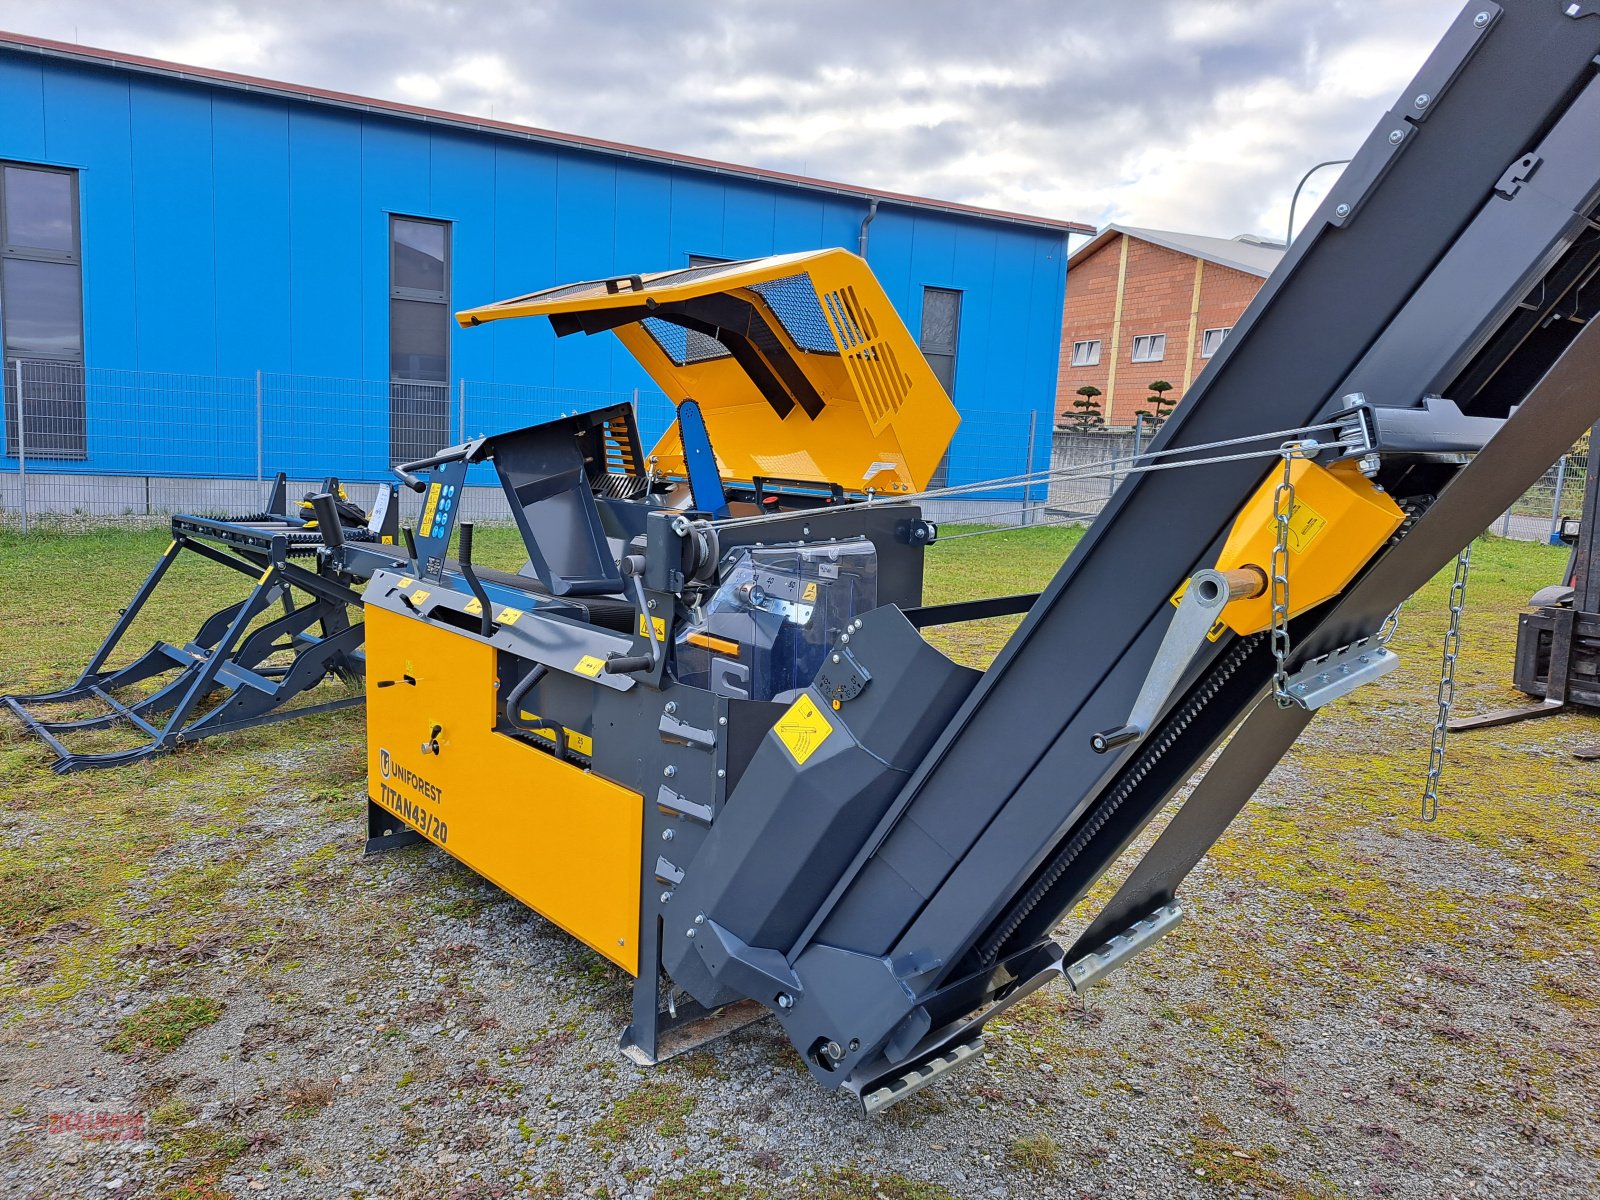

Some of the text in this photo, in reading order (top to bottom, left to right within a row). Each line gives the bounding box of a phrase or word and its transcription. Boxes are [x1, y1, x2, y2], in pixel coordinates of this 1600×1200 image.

[766, 576, 775, 585] 40
[788, 581, 796, 590] 50
[577, 736, 584, 746] 25
[391, 760, 443, 804] UNIFOREST
[380, 782, 448, 844] TITAN43/20
